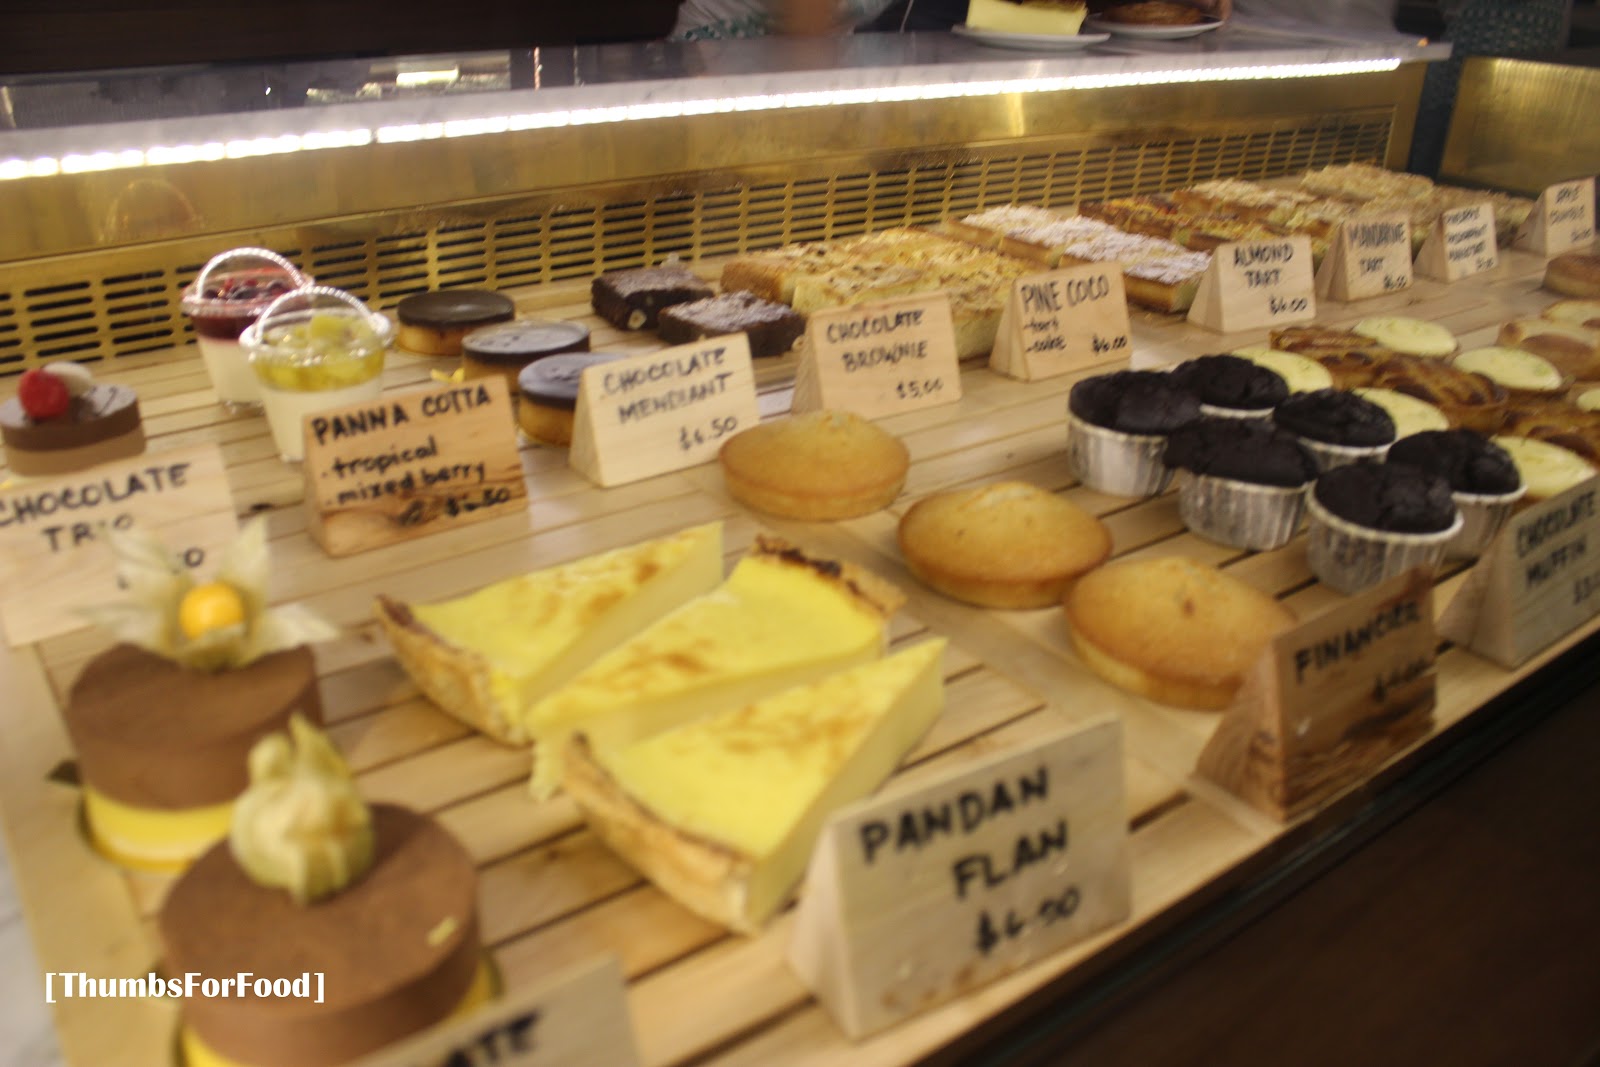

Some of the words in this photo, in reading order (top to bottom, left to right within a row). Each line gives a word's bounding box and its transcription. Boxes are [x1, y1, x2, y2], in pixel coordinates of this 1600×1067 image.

[1233, 243, 1294, 268] ALMOND
[1244, 267, 1282, 289] TART
[1020, 280, 1063, 314] PINE
[1066, 274, 1109, 308] COCO
[826, 308, 925, 344] CHOCOLATE
[603, 346, 727, 396] CHOCOLATE
[842, 340, 928, 373] BROWNIE
[311, 402, 410, 446] PANNA
[420, 383, 492, 418] COTTA
[617, 371, 735, 425] MENDIANT
[859, 764, 1051, 866] PANDAN
[953, 817, 1069, 899] FLAN
